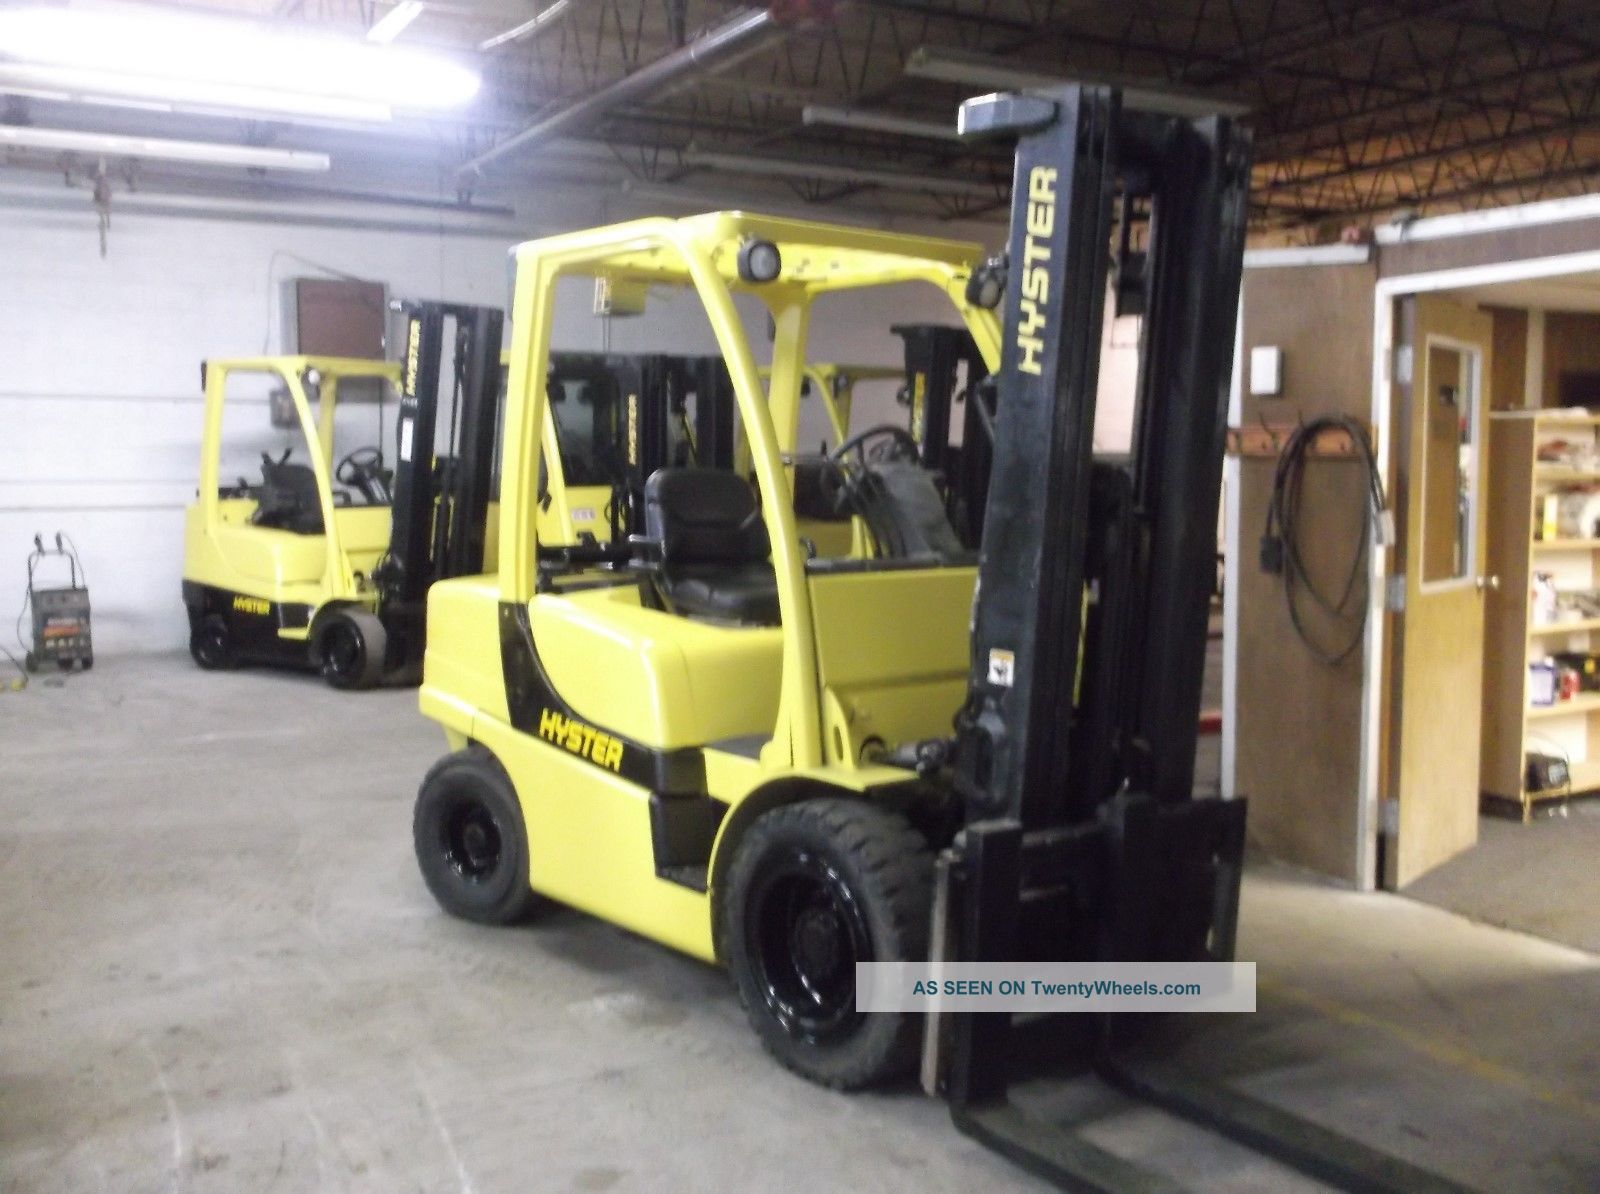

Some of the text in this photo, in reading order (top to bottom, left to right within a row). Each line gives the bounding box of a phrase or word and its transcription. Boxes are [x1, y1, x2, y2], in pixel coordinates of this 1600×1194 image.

[1017, 166, 1058, 376] HYSTER
[233, 596, 270, 616] HYSTER
[539, 707, 624, 773] HYSTER
